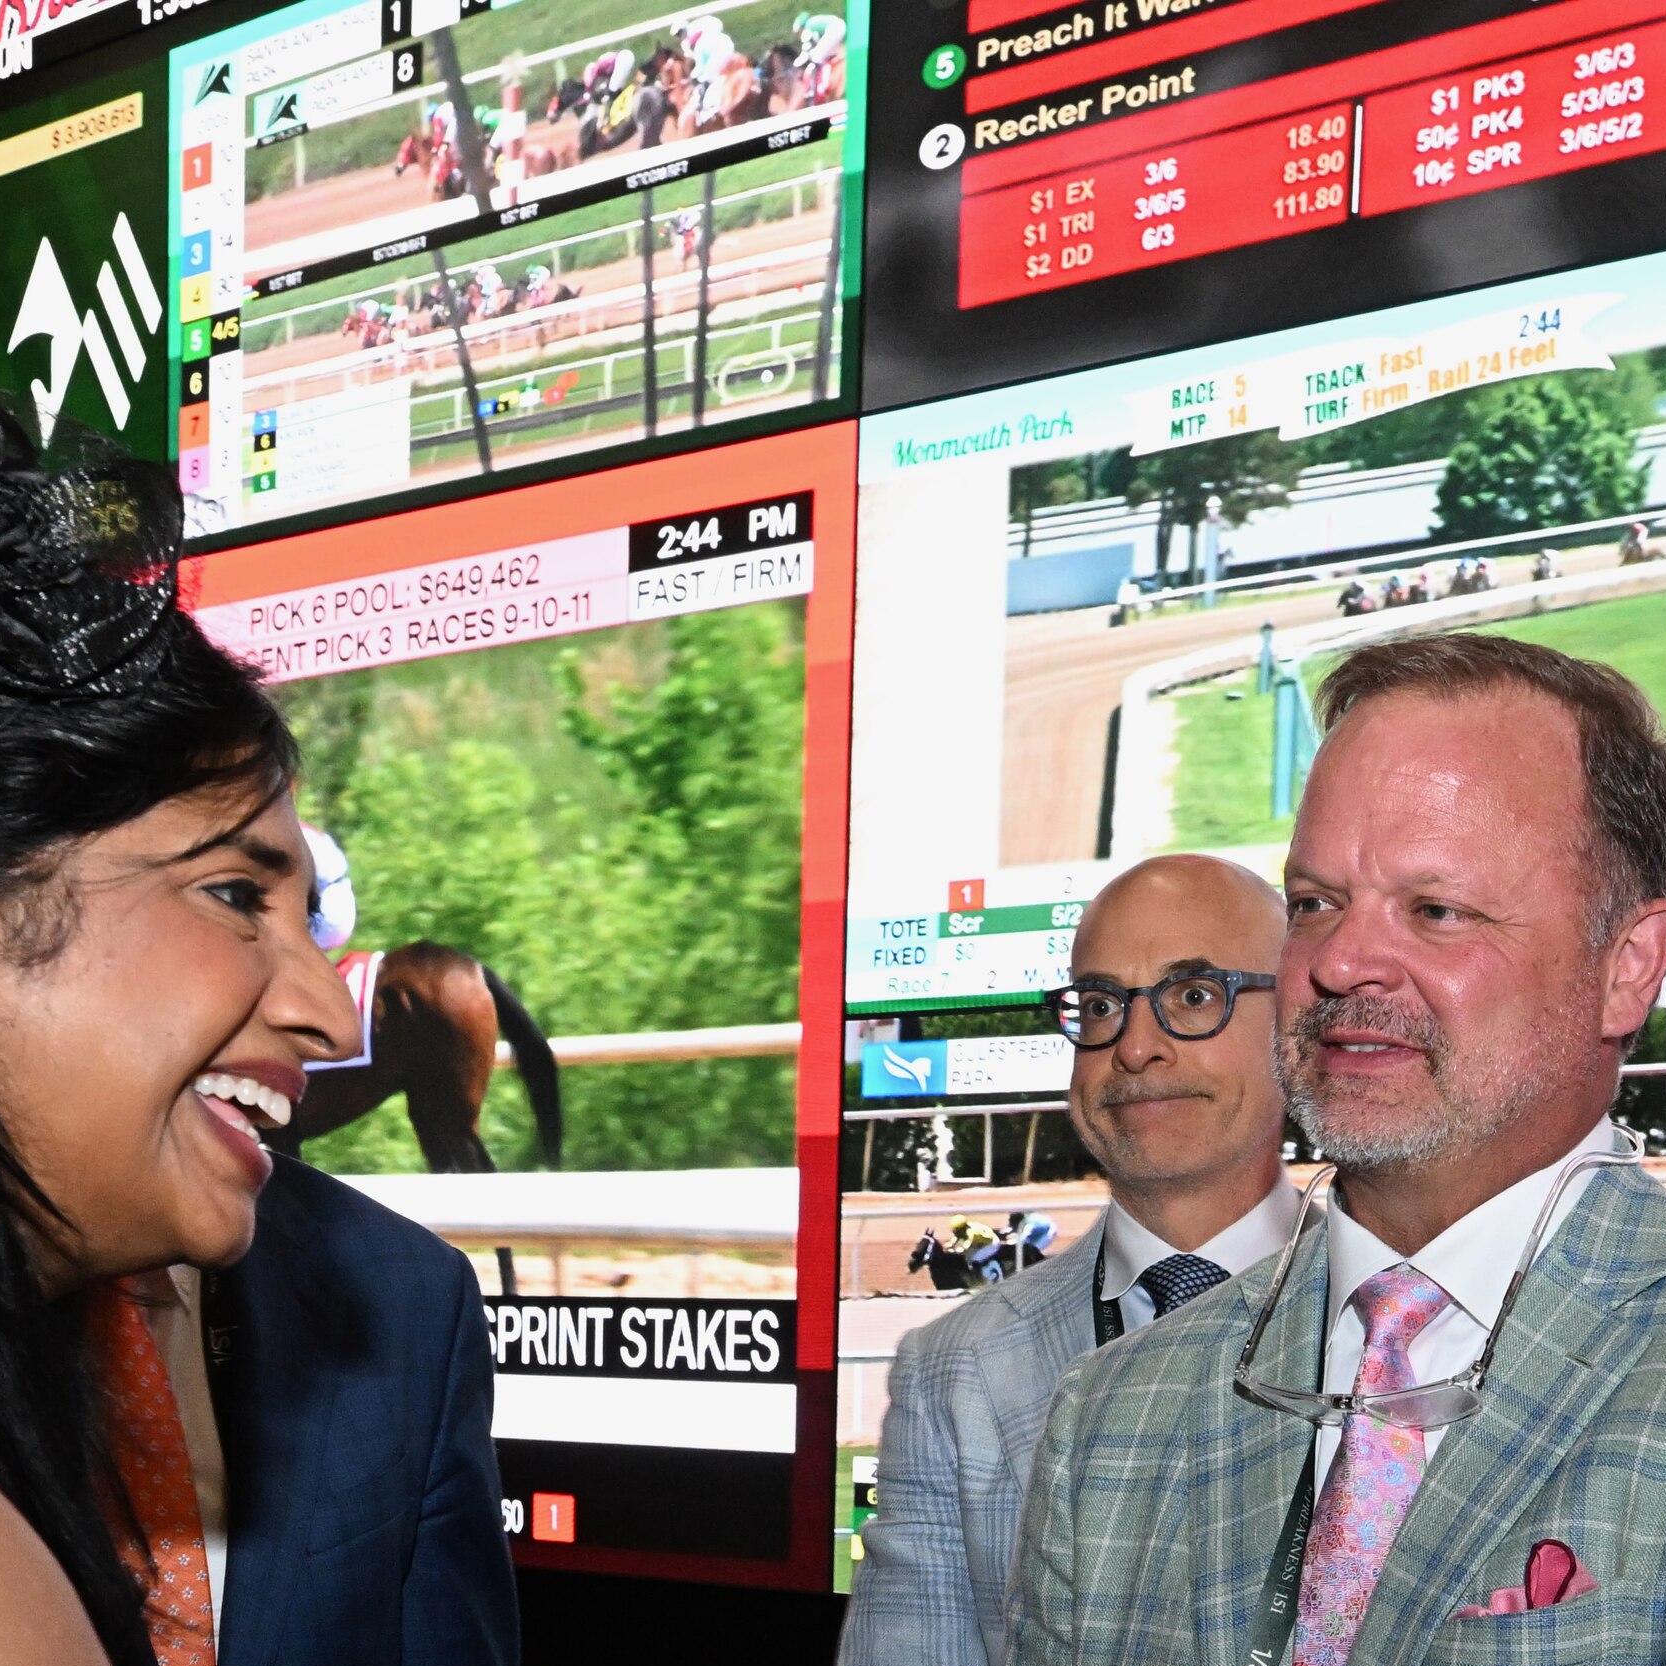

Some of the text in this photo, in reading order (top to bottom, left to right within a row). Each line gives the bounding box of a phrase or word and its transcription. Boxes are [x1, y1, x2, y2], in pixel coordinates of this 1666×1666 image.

[390, 0, 401, 32] 1
[935, 2, 1129, 79] 5 Preach It
[397, 53, 414, 82] 8
[1431, 85, 1460, 116] $1
[1473, 70, 1526, 106] PK3
[1573, 42, 1636, 80] 3/6/3
[936, 66, 1196, 158] 2 Recker Point
[1415, 123, 1460, 154] 50¢
[1472, 105, 1524, 143] PK4
[1561, 76, 1645, 119] 5/3/6/3
[193, 157, 201, 178] 1
[1030, 115, 1346, 216] $1 EX 3/6 18.40
[1412, 157, 1455, 189] 10¢
[1466, 142, 1522, 178] SPR
[1559, 112, 1644, 155] 3/6/5/2
[1023, 149, 1345, 248] $1 TRI 3/6/5 83.90
[191, 243, 204, 266] 3
[1025, 183, 1344, 280] $2 DD 6/3 111.80
[190, 316, 239, 351] 5 4/5
[1379, 343, 1424, 378] Fast
[189, 372, 203, 394] 6
[1235, 373, 1247, 399] 5
[1362, 380, 1410, 416] Firm
[1428, 360, 1471, 396] Rail
[1478, 354, 1502, 384] 24
[1510, 338, 1558, 374] Feet
[190, 416, 201, 437] 7
[893, 410, 1074, 468] Monmouth Park
[1228, 404, 1248, 430] 14
[191, 459, 200, 479] 8
[657, 502, 796, 560] 2:44 PM
[250, 553, 541, 636] PICK 6 POOL: $649,462
[637, 553, 803, 609] FAST FIRM
[314, 593, 592, 666] PICK 3 RACES 9-10-11
[962, 876, 1074, 904] 1 2
[880, 902, 1083, 939] TOTE Scr 5/2
[874, 946, 927, 967] FIXED
[484, 1305, 780, 1372] SPRINT STAKES
[550, 1504, 558, 1530] 1
[1270, 1493, 1313, 1613] PREAKNESS 151
